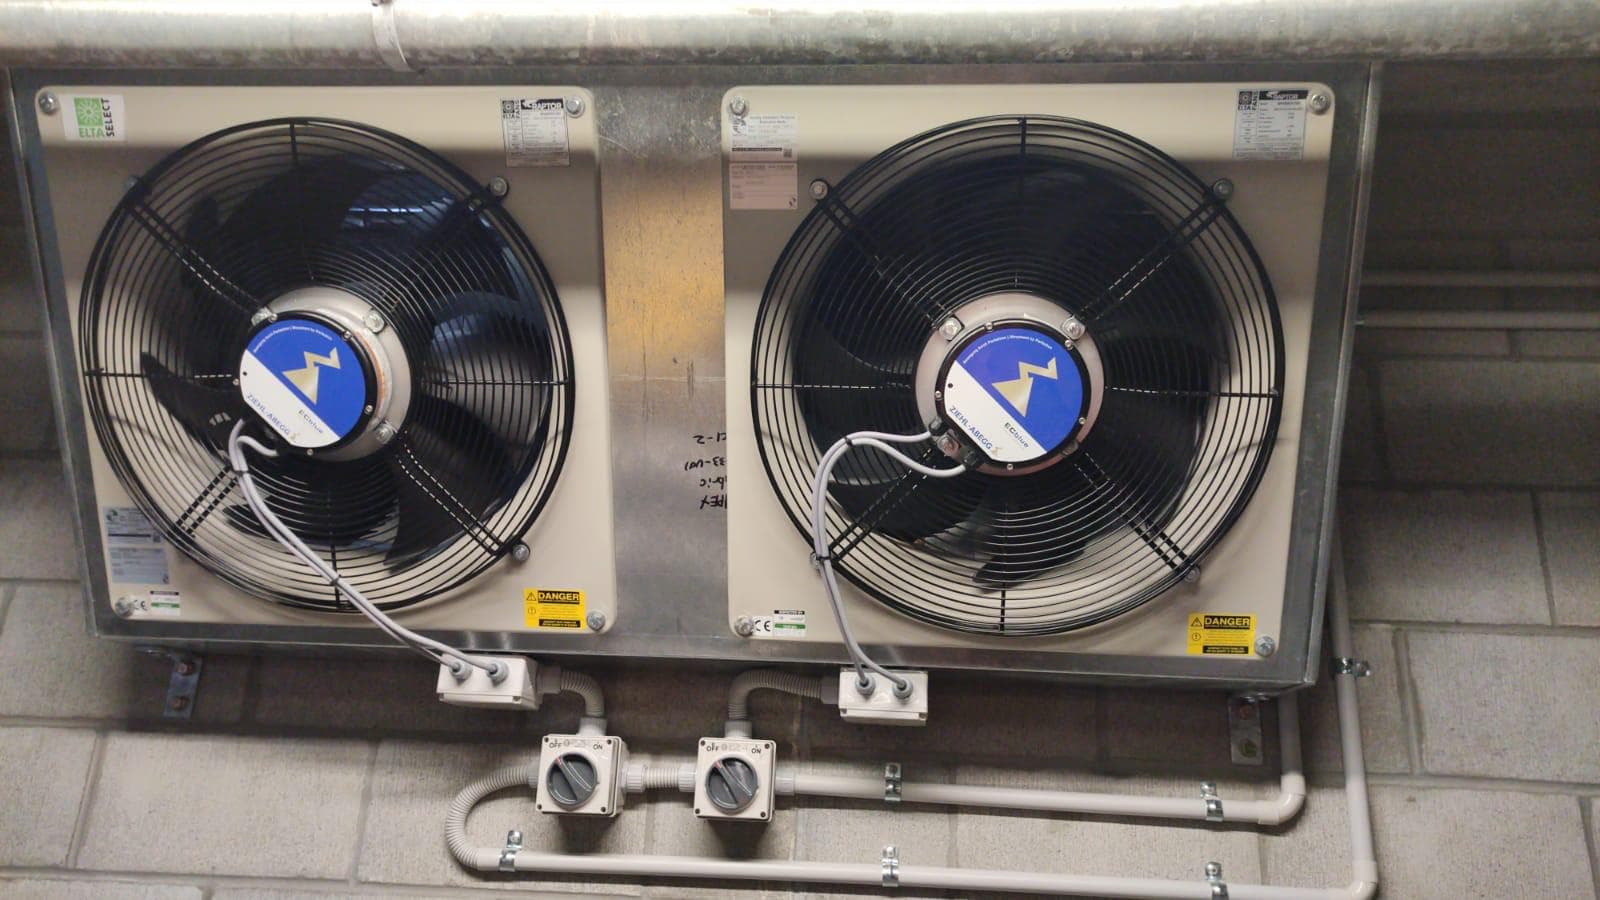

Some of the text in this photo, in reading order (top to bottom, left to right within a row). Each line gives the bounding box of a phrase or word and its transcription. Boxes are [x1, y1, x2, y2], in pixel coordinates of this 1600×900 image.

[101, 97, 115, 137] SELECT
[79, 128, 105, 138] ELTA
[247, 394, 290, 435] ZIEHL-ABEGG
[949, 405, 993, 450] ZIEHL-ABEGG
[1004, 422, 1029, 448] ECblue
[538, 592, 579, 601] DANGER
[1205, 617, 1250, 626] DANGER
[706, 744, 719, 752] OFF
